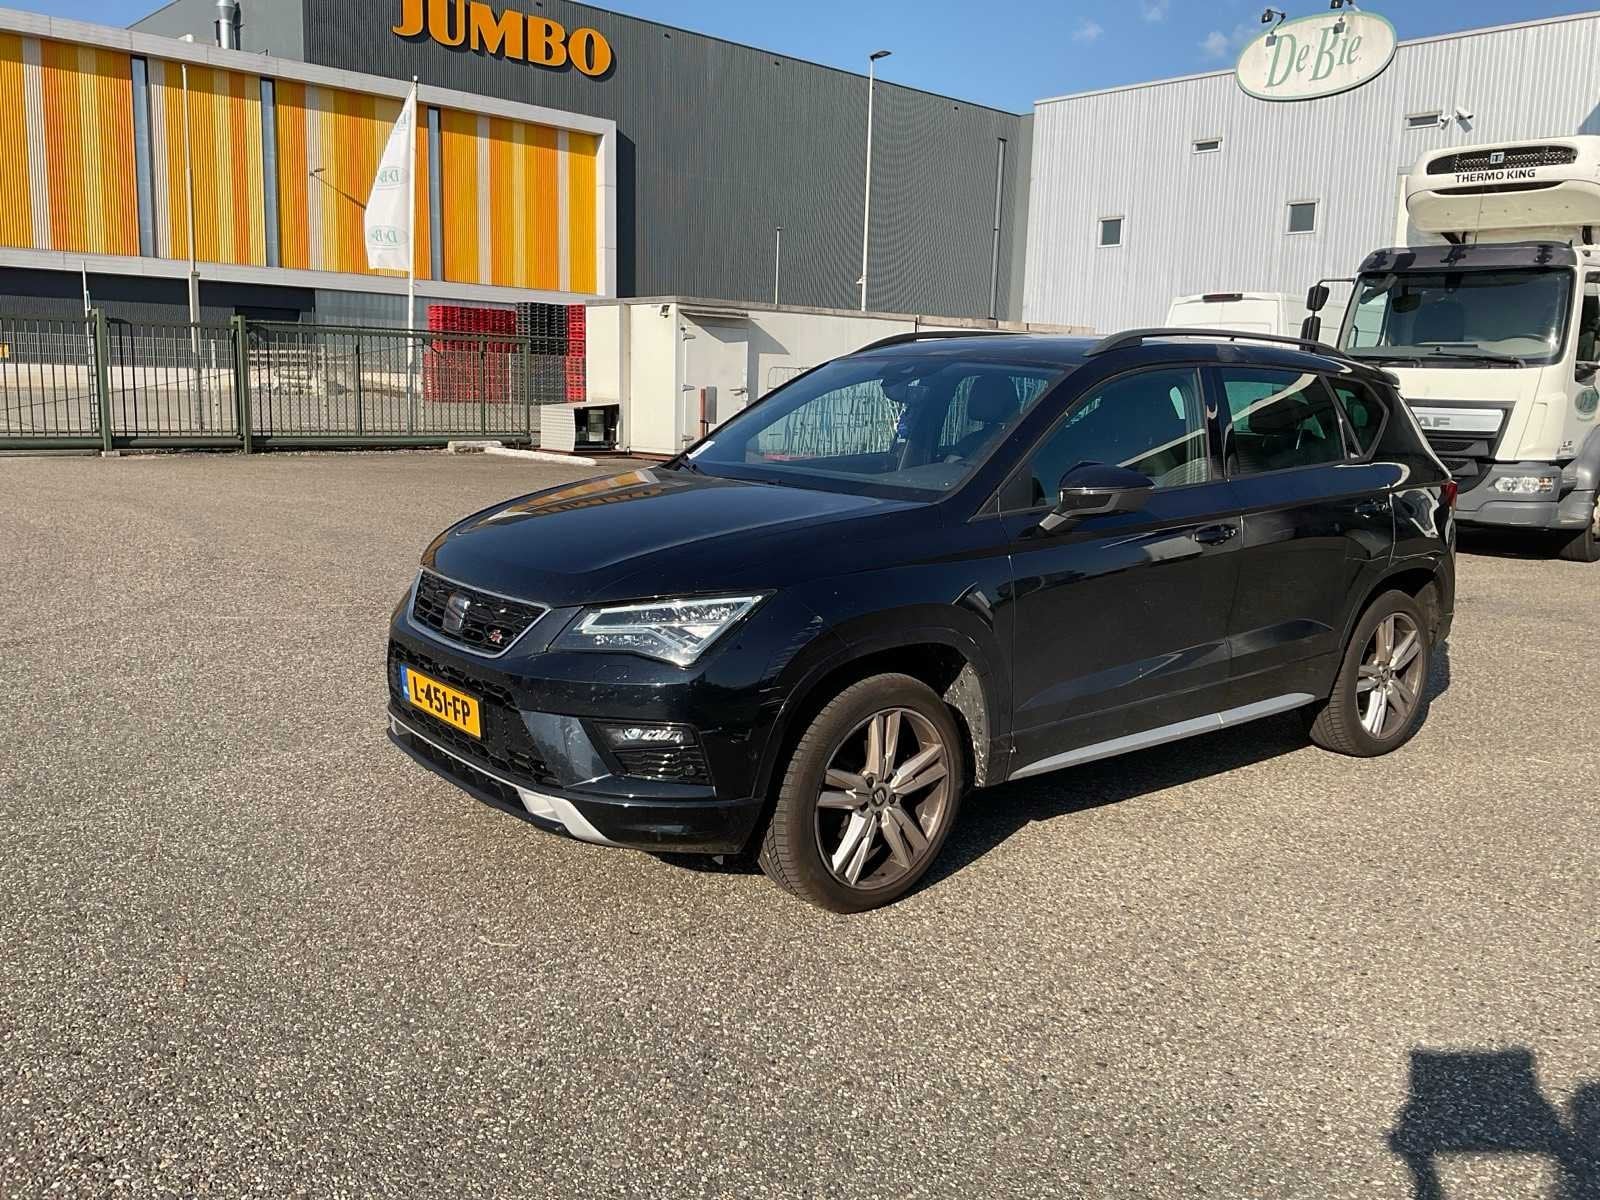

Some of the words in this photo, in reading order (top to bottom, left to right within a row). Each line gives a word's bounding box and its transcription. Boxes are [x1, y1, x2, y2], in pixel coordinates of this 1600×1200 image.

[392, 0, 612, 76] JUMBO
[1264, 34, 1310, 88] De
[1308, 25, 1362, 81] Bie
[1455, 171, 1505, 183] THERMO
[1506, 168, 1536, 179] KING
[1418, 416, 1450, 427] AF
[413, 676, 471, 726] L-451-FP
